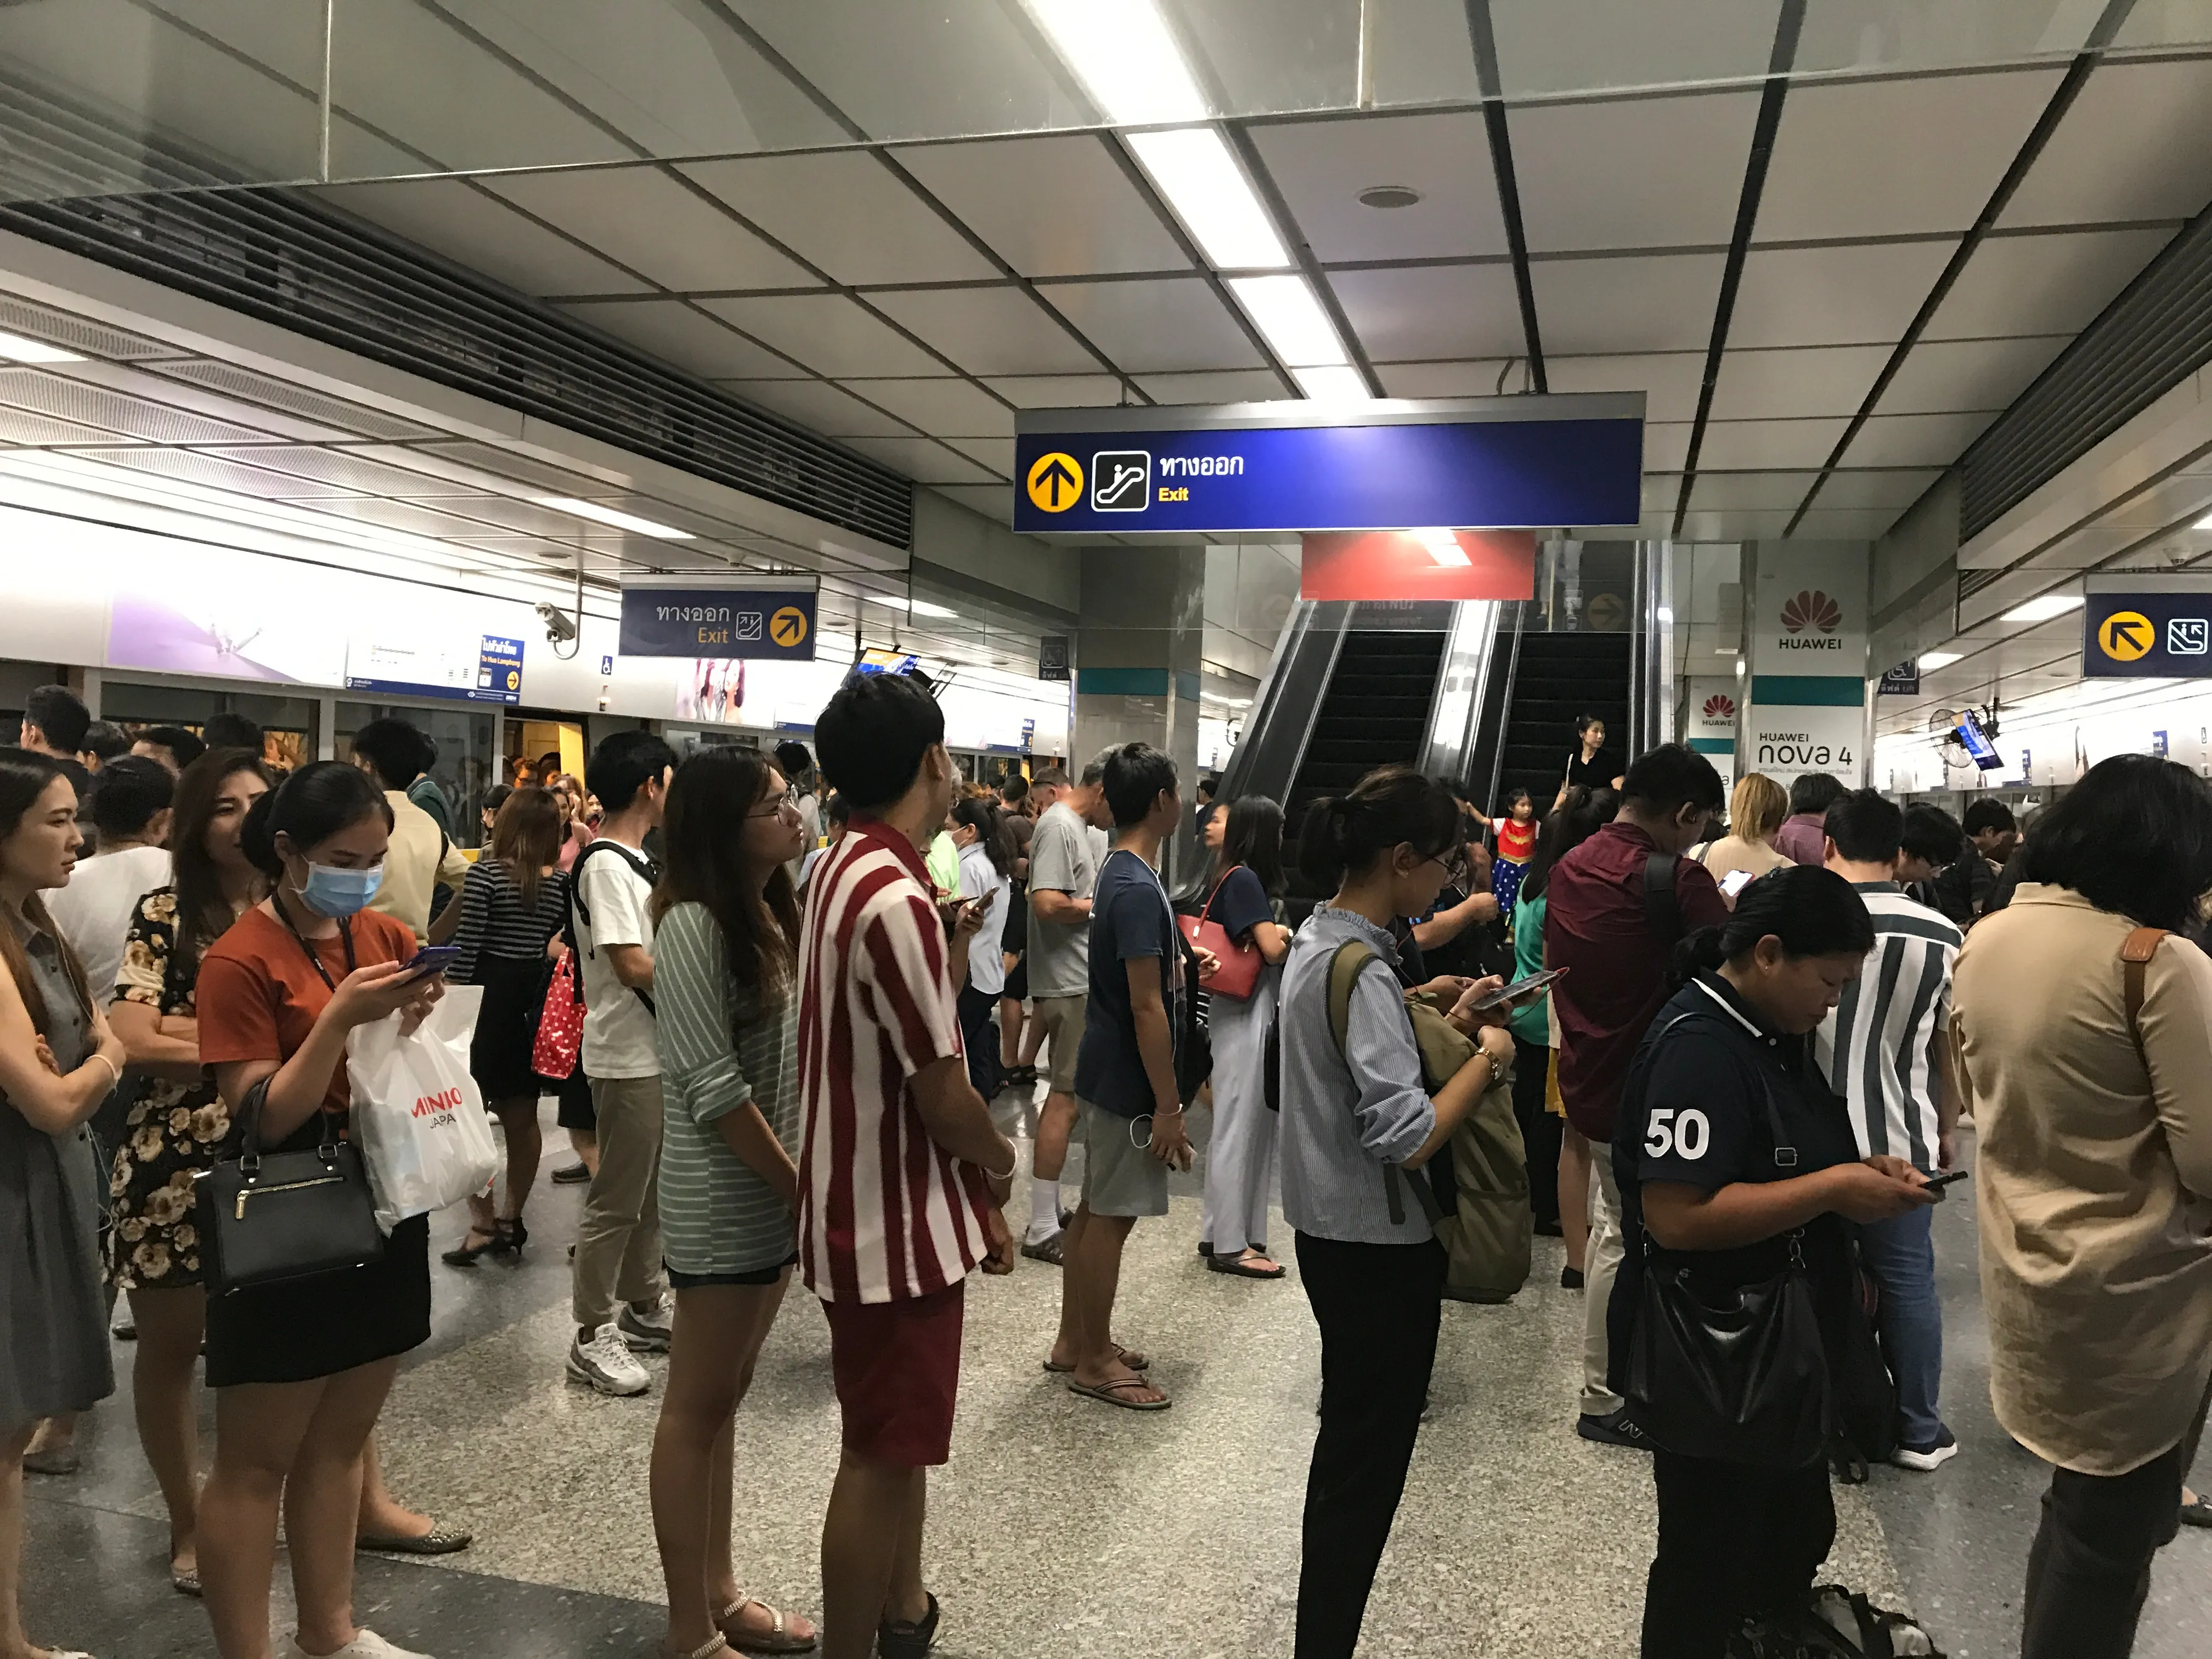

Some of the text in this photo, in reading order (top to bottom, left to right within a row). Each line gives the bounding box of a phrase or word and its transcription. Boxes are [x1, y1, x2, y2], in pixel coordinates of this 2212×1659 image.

[1159, 456, 1244, 476] ทางออก
[1158, 487, 1189, 502] Exit
[656, 606, 730, 622] ทางออก
[697, 626, 729, 644] Exit
[1779, 638, 1842, 650] HUAWEI
[1759, 732, 1809, 742] HUAWEI
[1758, 744, 1853, 766] nova 4
[430, 1113, 457, 1129] JAPA
[1644, 1108, 1710, 1160] 50
